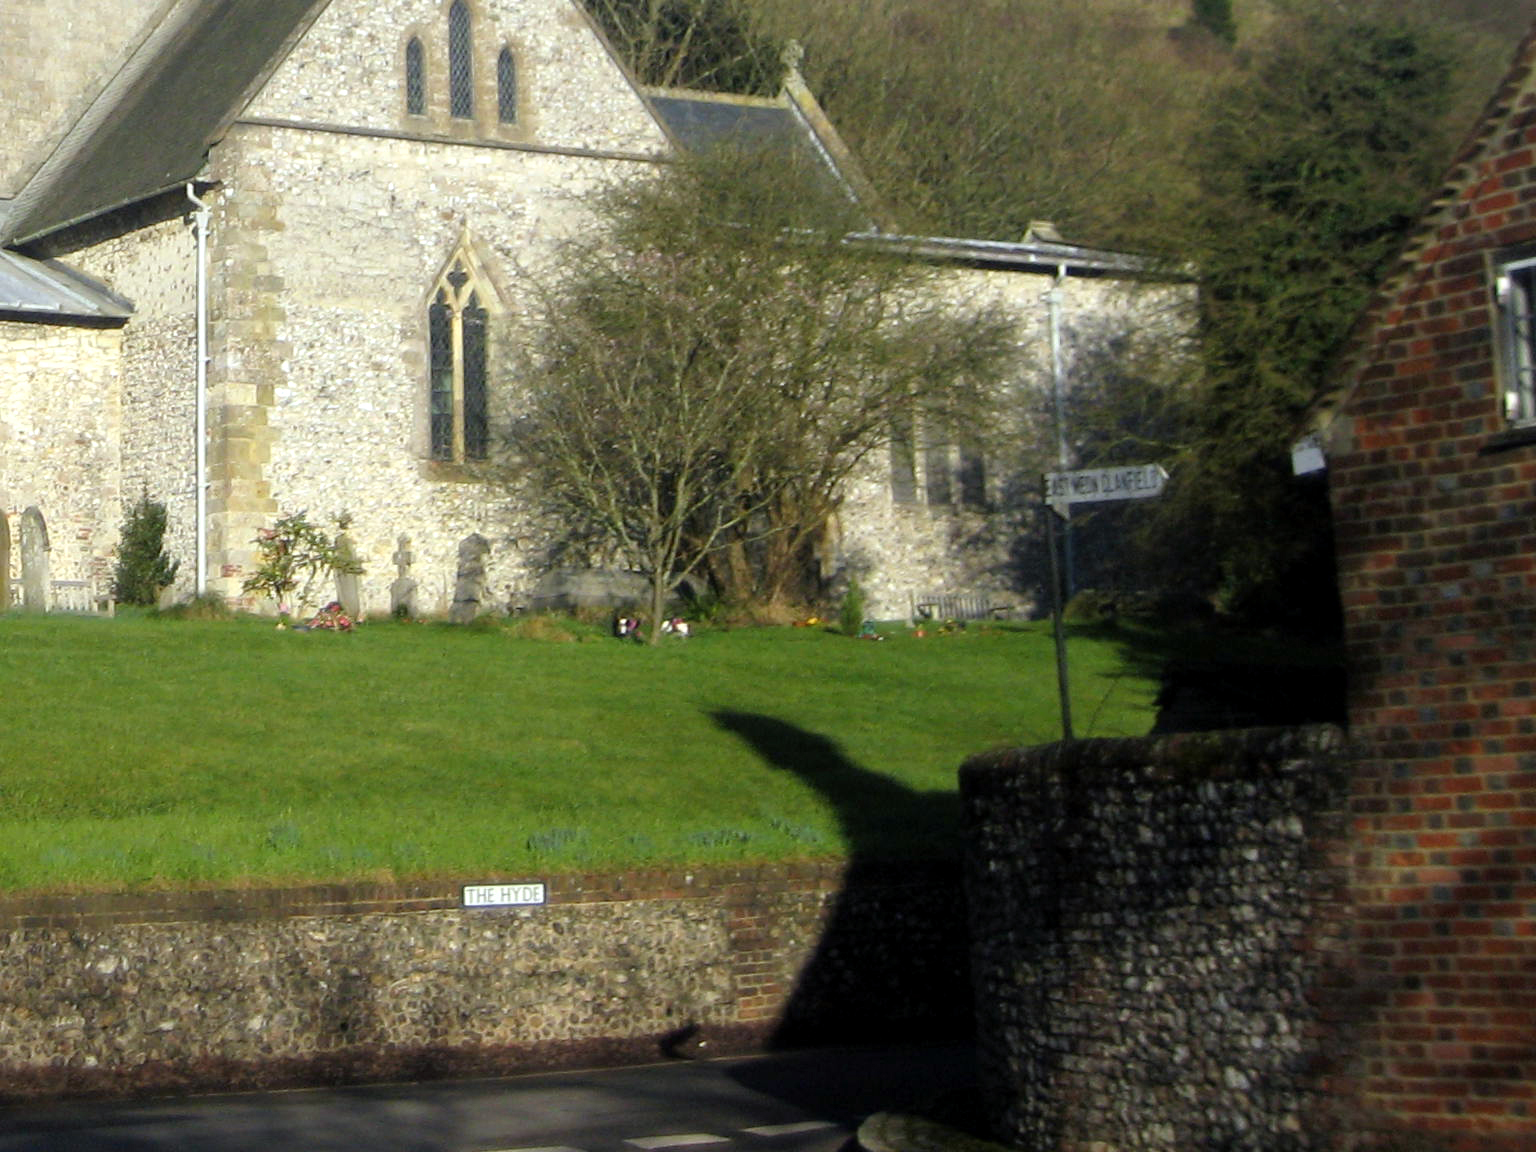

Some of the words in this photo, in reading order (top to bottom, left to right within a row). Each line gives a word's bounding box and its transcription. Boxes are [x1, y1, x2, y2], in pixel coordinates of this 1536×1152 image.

[1101, 469, 1158, 493] CLANFIELD
[467, 888, 495, 904] THE
[501, 886, 541, 902] HYDE
